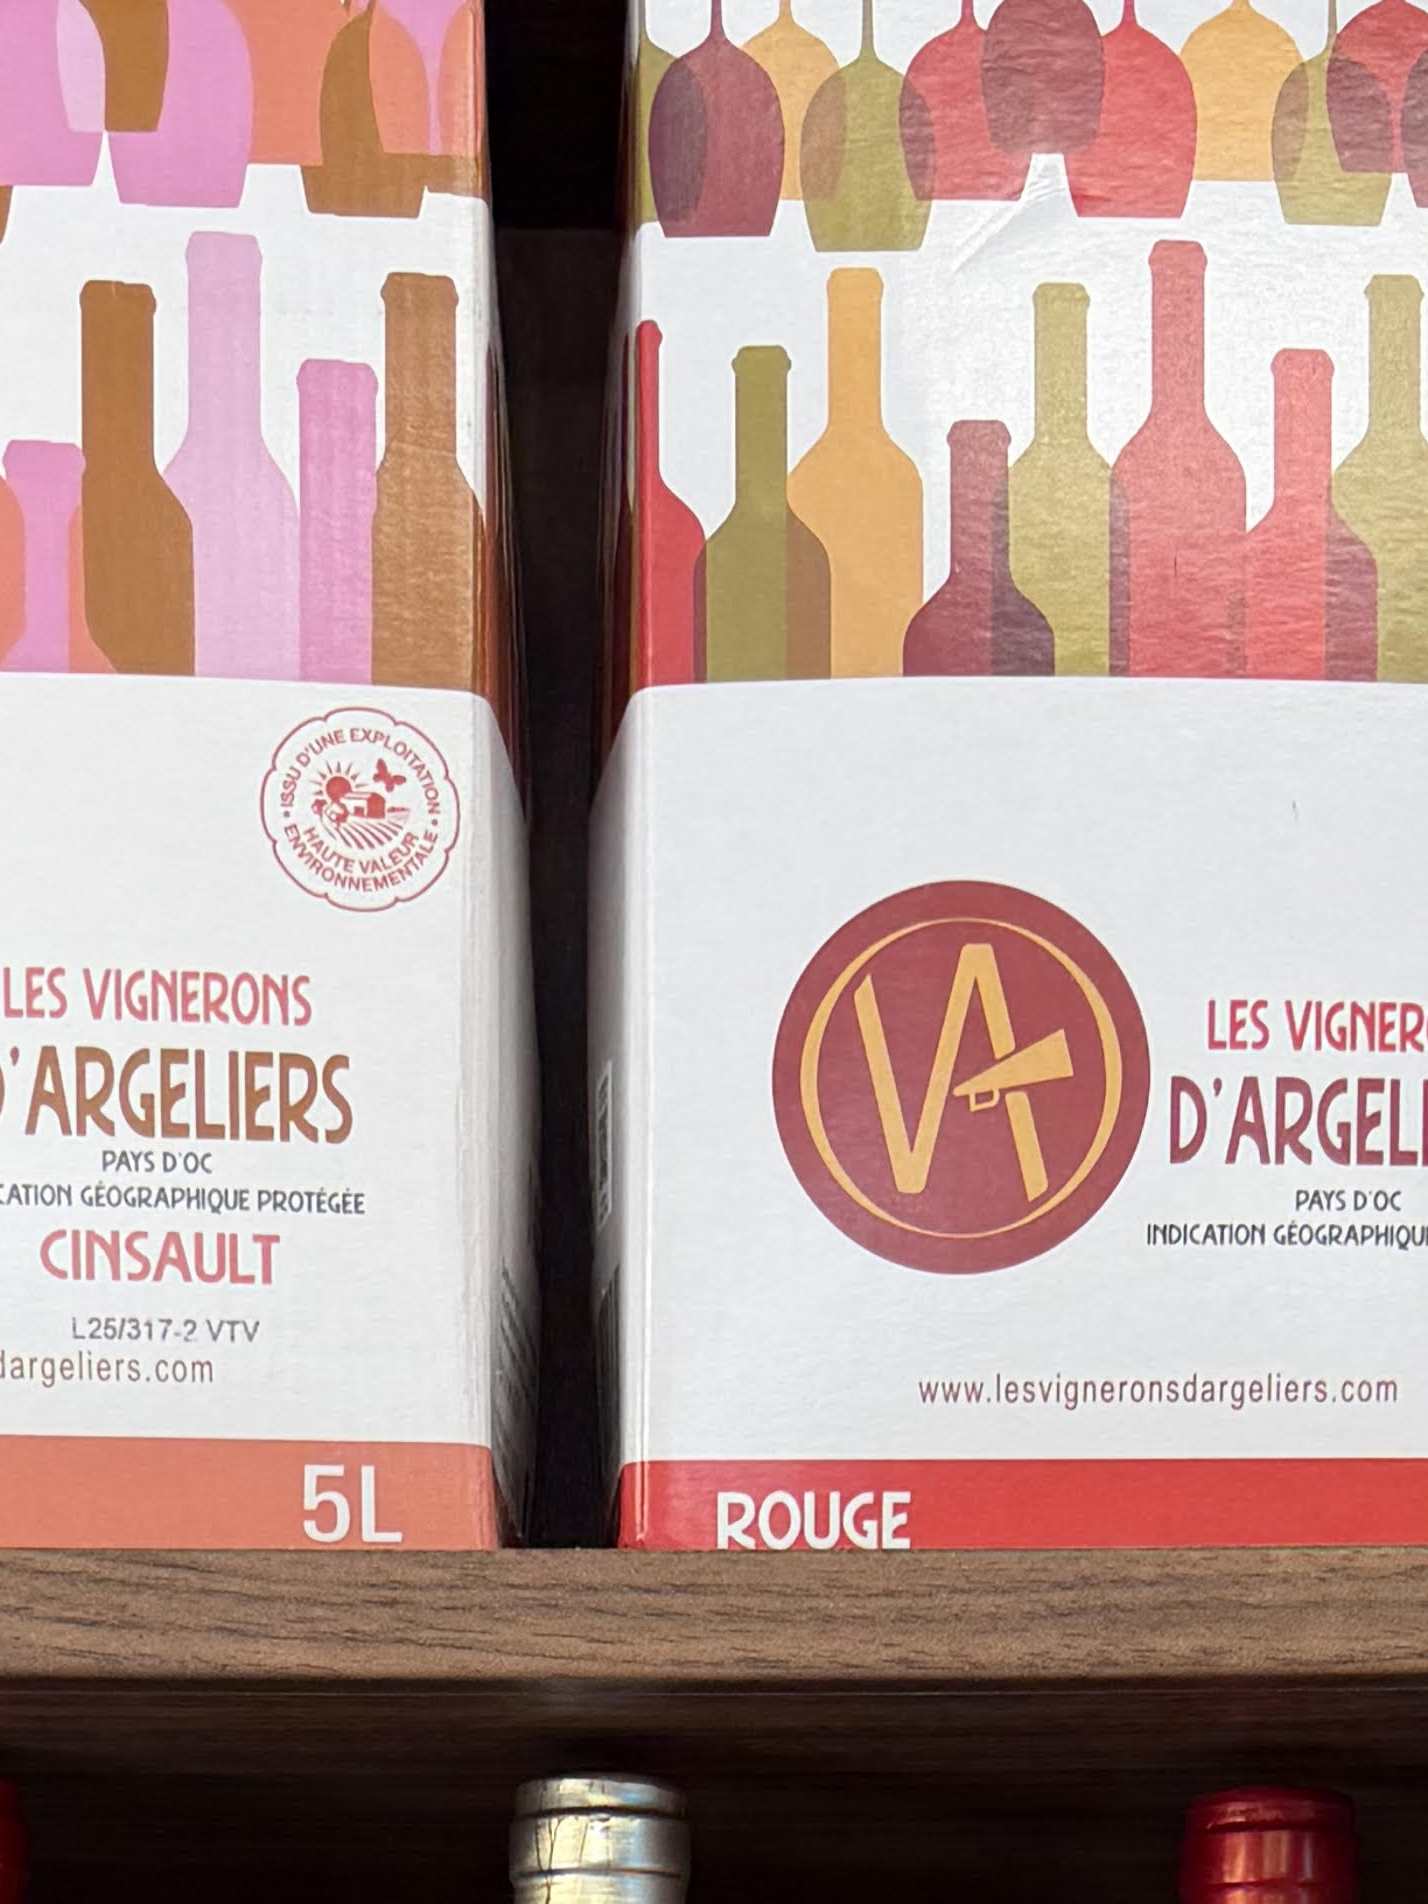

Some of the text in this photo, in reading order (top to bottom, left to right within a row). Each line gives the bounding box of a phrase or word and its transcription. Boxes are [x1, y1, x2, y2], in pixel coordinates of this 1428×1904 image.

[350, 727, 441, 814] EXPLOITATION
[284, 824, 438, 891] ENVIRONNEMENTALE
[304, 827, 419, 874] HAUTE VALEUR
[3, 967, 311, 1026] LES VIGNERONS
[1207, 1000, 1268, 1051] LES
[102, 1150, 212, 1174] PAYS D'OC
[80, 1179, 249, 1215] GÉOGRAPHIQUE
[258, 1185, 364, 1215] PROTÉGÉE
[1295, 1189, 1401, 1212] PAYS D'OC
[40, 1229, 279, 1286] CINSAULT
[1146, 1223, 1266, 1247] INDICATION
[71, 1318, 259, 1343] L25/317-2 VTV
[919, 1371, 1398, 1409] www.lesvigneronsdargeliers.com
[302, 1464, 401, 1544] 5L
[716, 1489, 910, 1549] ROUGE
